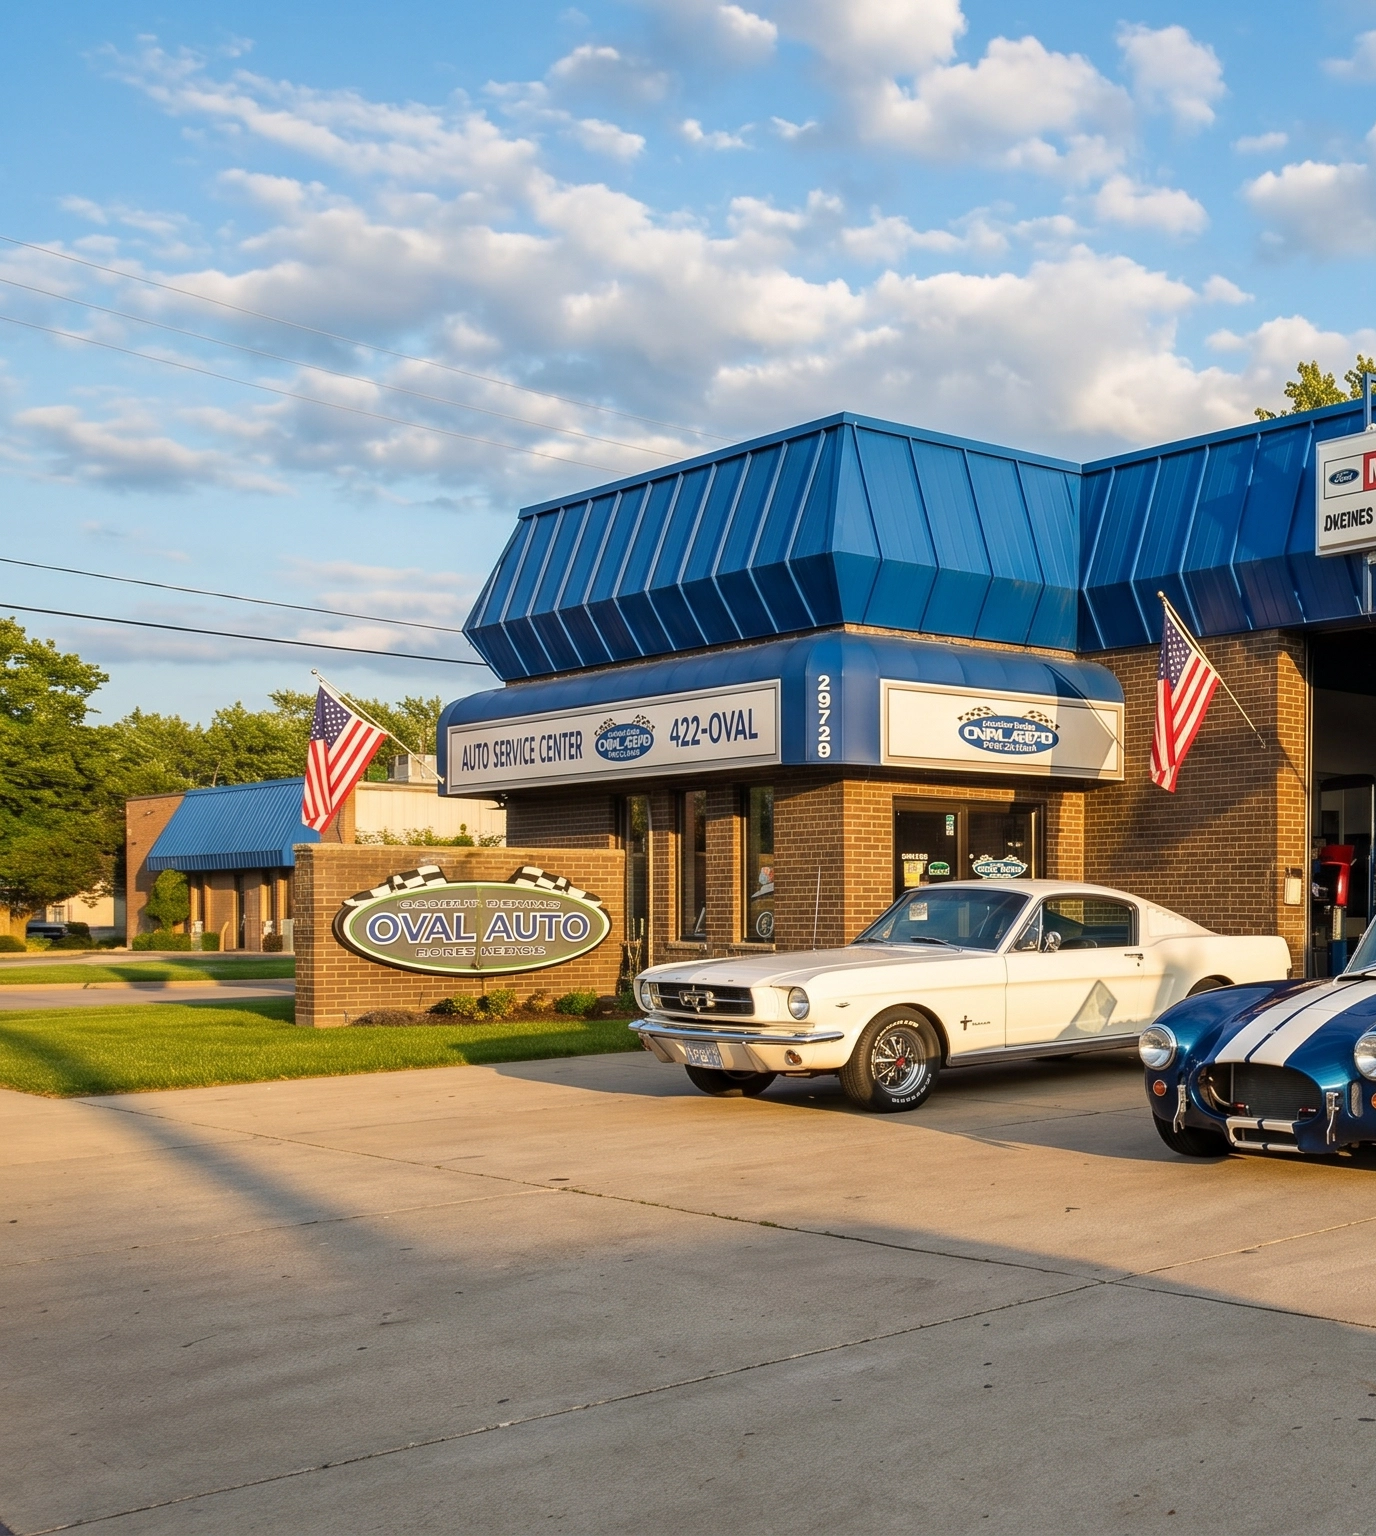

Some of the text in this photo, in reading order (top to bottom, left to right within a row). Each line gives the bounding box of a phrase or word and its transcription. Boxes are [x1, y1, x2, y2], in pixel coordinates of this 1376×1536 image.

[669, 708, 759, 748] 422-OVAL
[817, 674, 831, 758] 29729
[461, 742, 489, 772] AUTO
[493, 736, 535, 768] SERVICE
[539, 730, 583, 763] CENTER
[365, 911, 591, 945] OVAL AUTO
